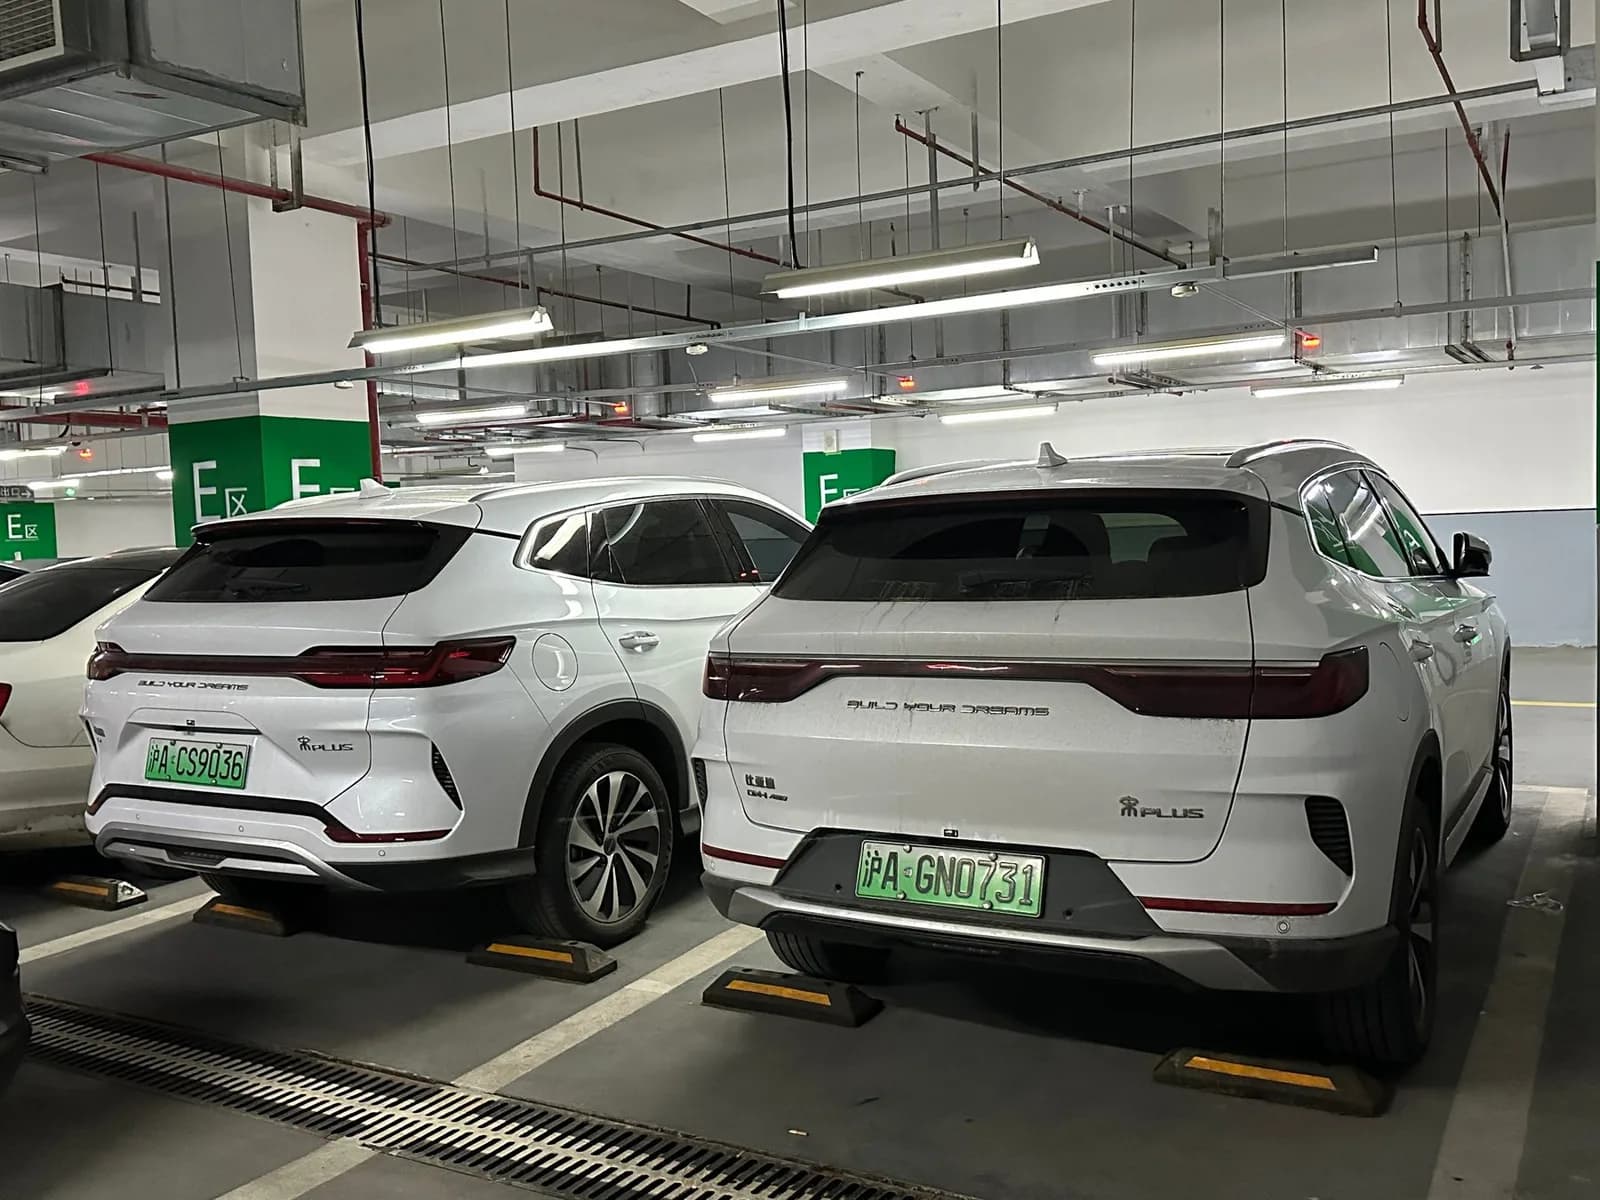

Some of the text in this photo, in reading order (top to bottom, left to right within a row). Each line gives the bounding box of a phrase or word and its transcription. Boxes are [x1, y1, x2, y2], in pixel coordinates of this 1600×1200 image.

[167, 681, 196, 689] YOUR
[197, 682, 249, 691] DREAMS
[847, 699, 1050, 716] BUILD YOUR DREAMS
[1140, 807, 1204, 819] PLUS
